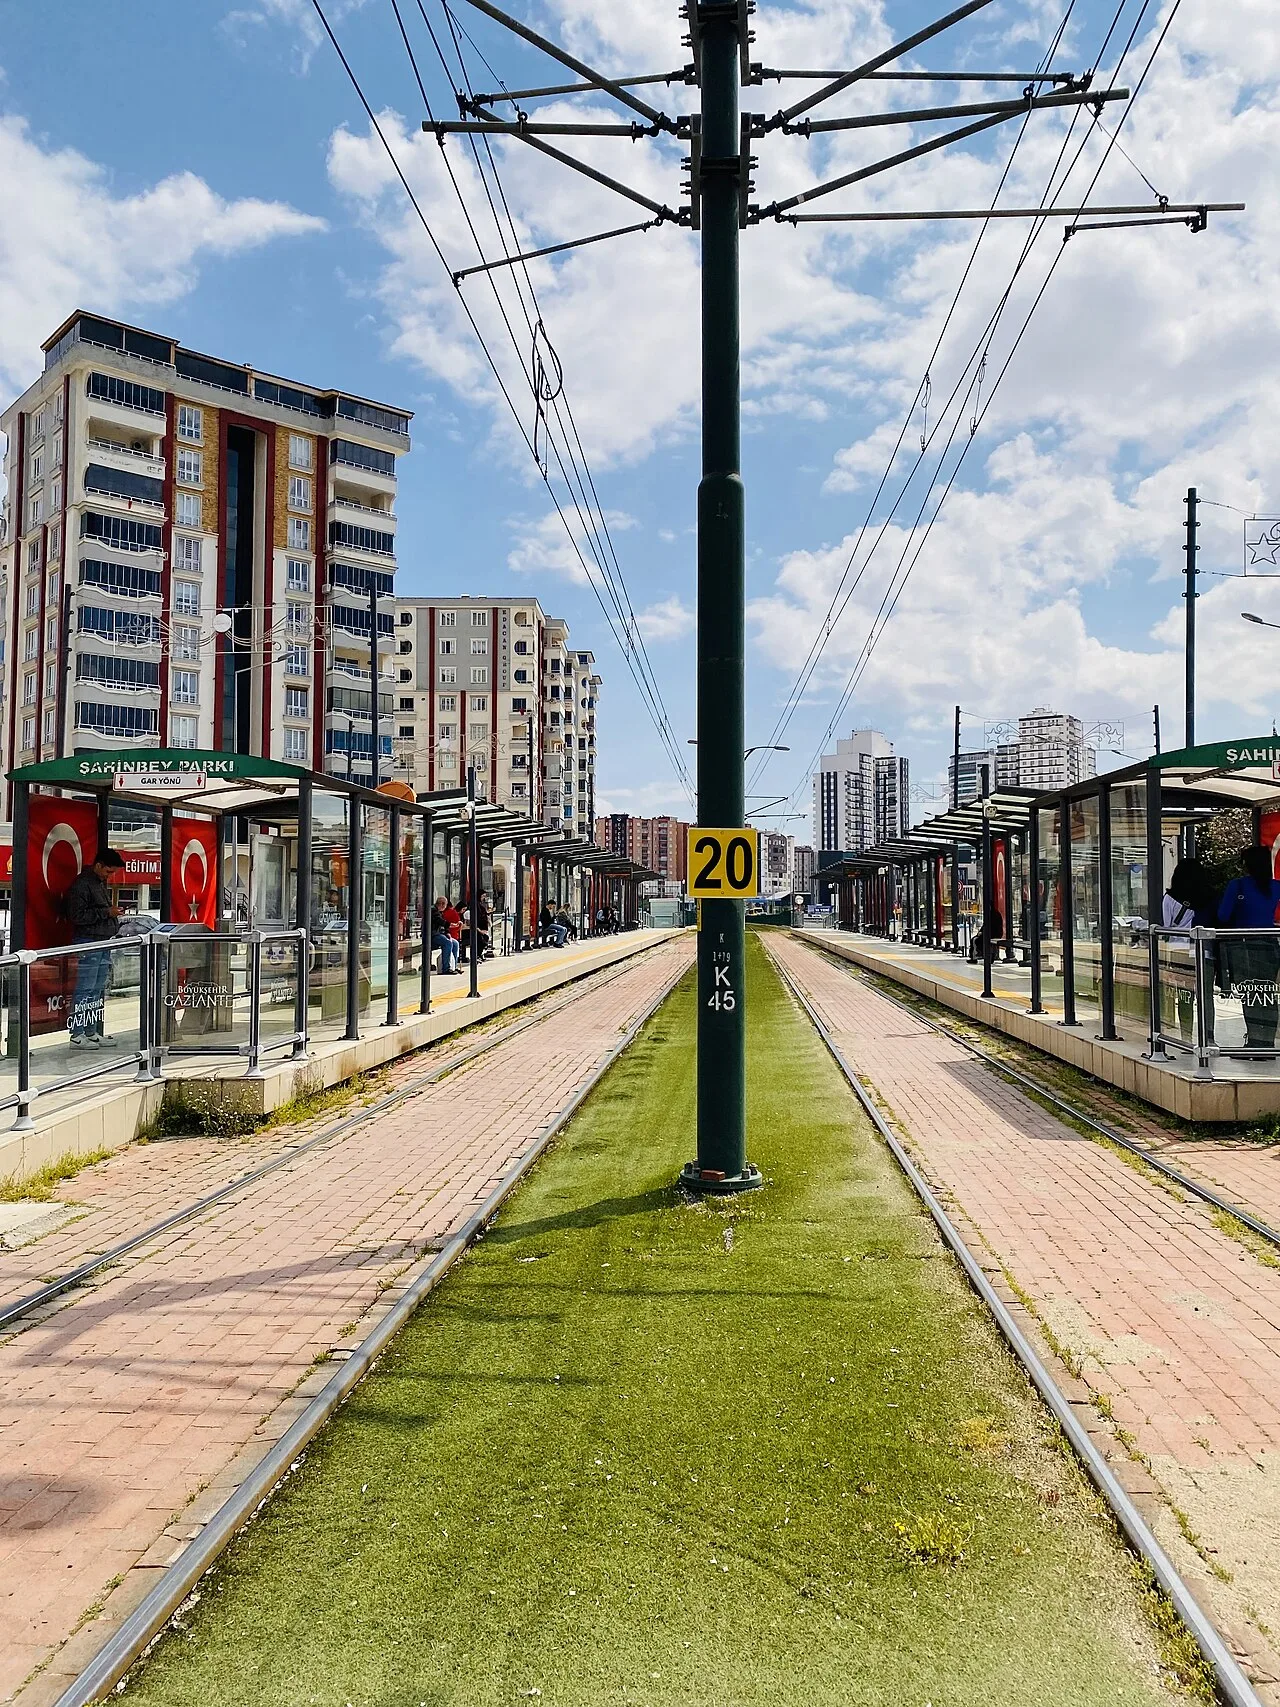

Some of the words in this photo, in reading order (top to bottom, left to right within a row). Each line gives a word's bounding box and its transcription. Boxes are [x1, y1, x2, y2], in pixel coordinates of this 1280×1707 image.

[79, 759, 173, 775] ŞAHİNBEY
[179, 760, 234, 772] PARKI
[141, 777, 157, 785] GAR
[158, 776, 181, 785] YÖNÜ
[125, 859, 157, 873] EĞİTİM
[694, 836, 753, 890] 20
[714, 966, 731, 987] K
[707, 990, 736, 1011] 45
